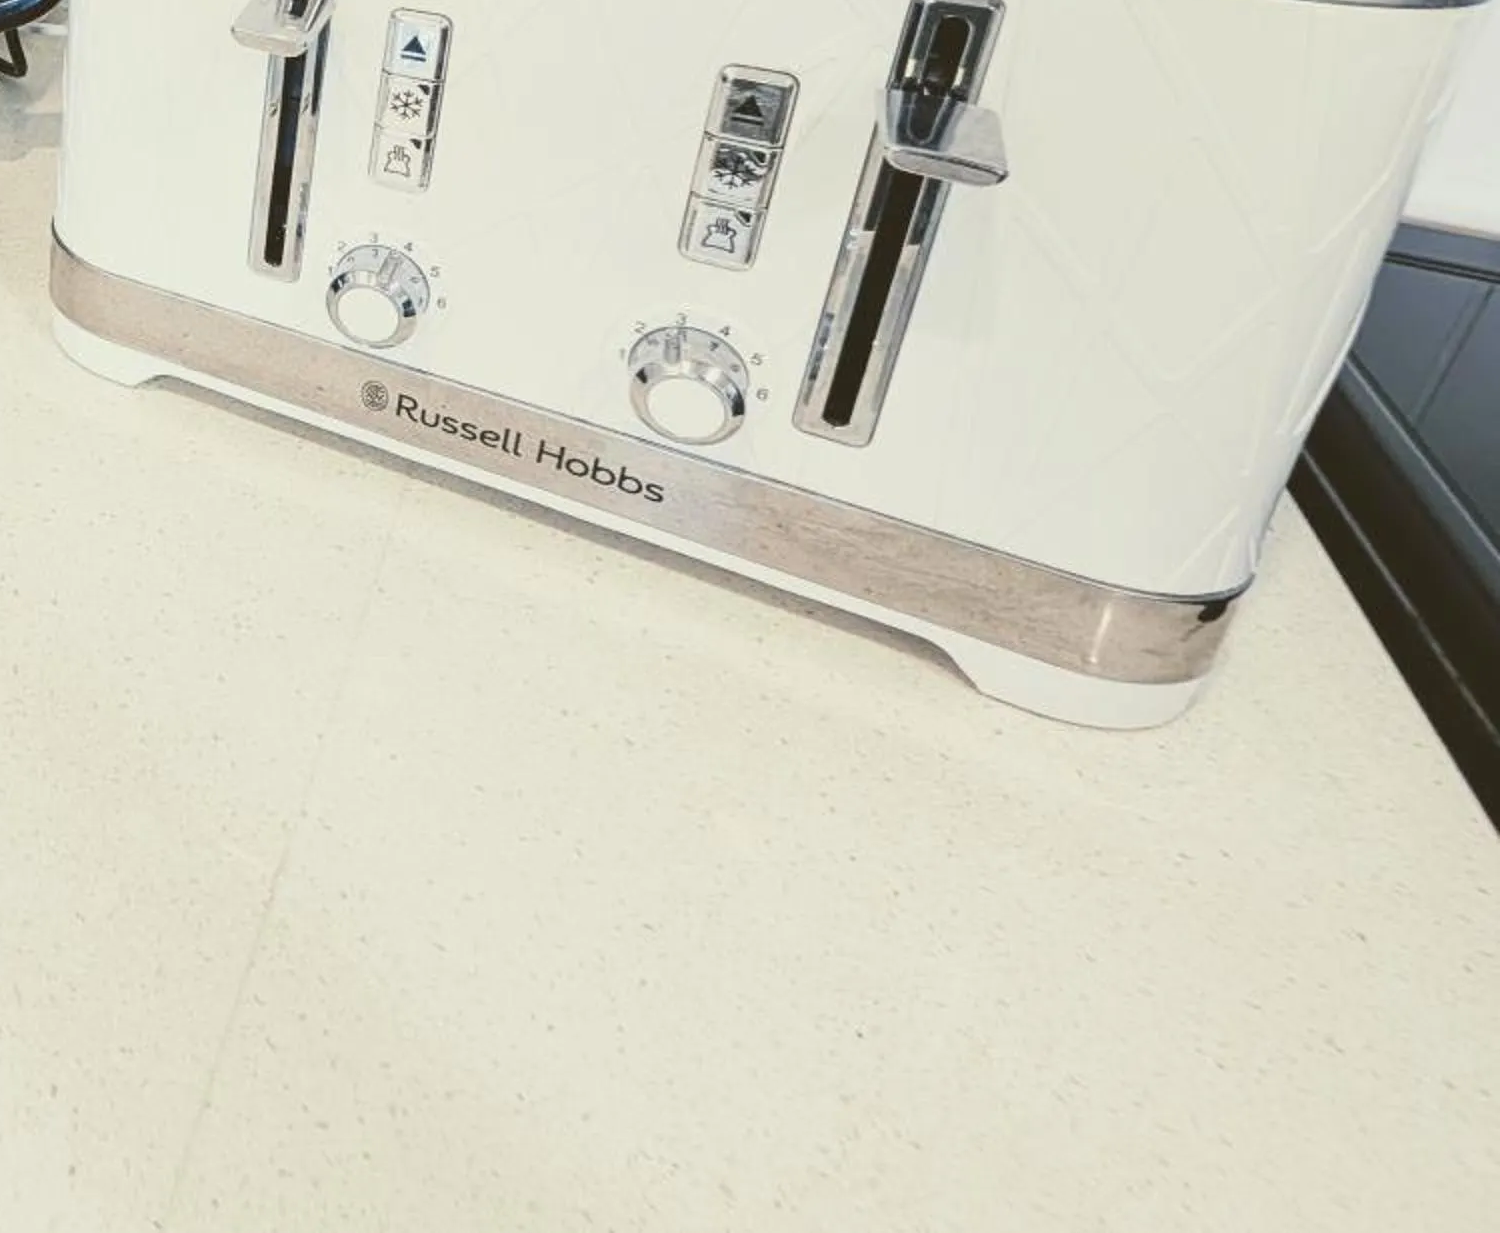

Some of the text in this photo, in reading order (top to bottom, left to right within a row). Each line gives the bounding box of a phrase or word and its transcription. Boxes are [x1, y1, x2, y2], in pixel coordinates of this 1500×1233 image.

[719, 325, 731, 337] 4
[750, 352, 764, 366] 5
[756, 388, 769, 401] 6
[395, 393, 665, 503] Russell Hobbs
